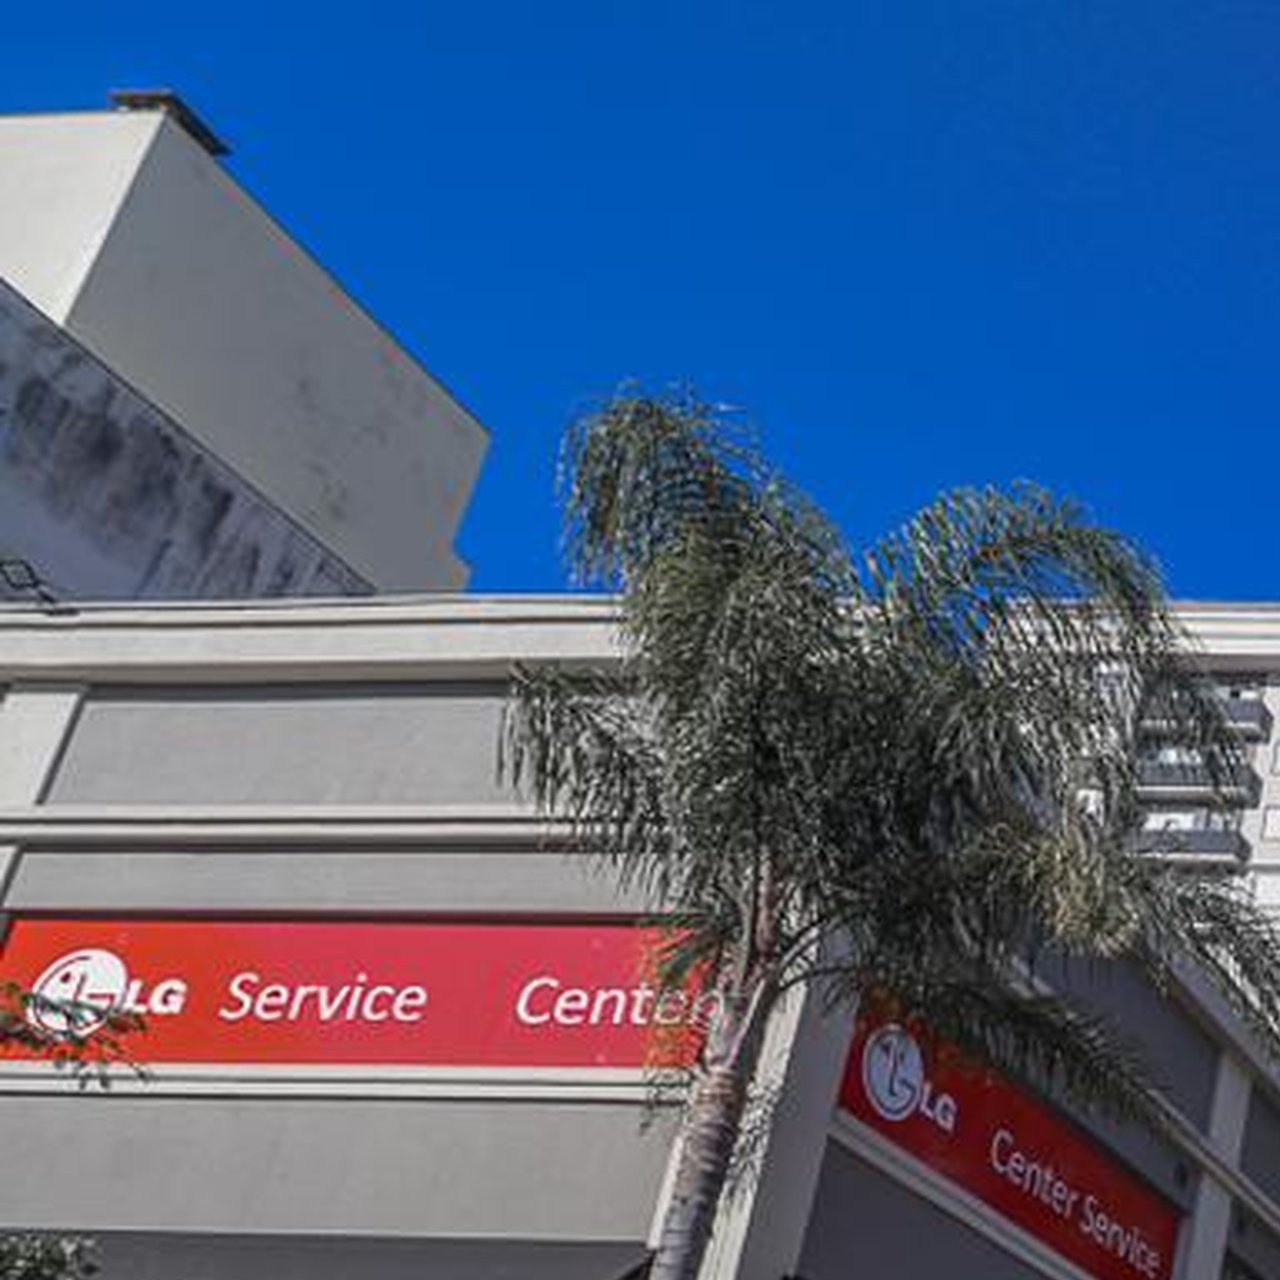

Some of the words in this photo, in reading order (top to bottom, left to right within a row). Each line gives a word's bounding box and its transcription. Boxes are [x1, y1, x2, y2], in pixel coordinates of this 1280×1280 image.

[120, 977, 188, 1015] LG
[218, 972, 428, 1022] Service
[918, 1081, 959, 1132] LG
[990, 1127, 1081, 1219] Center
[1078, 1194, 1161, 1279] Service
